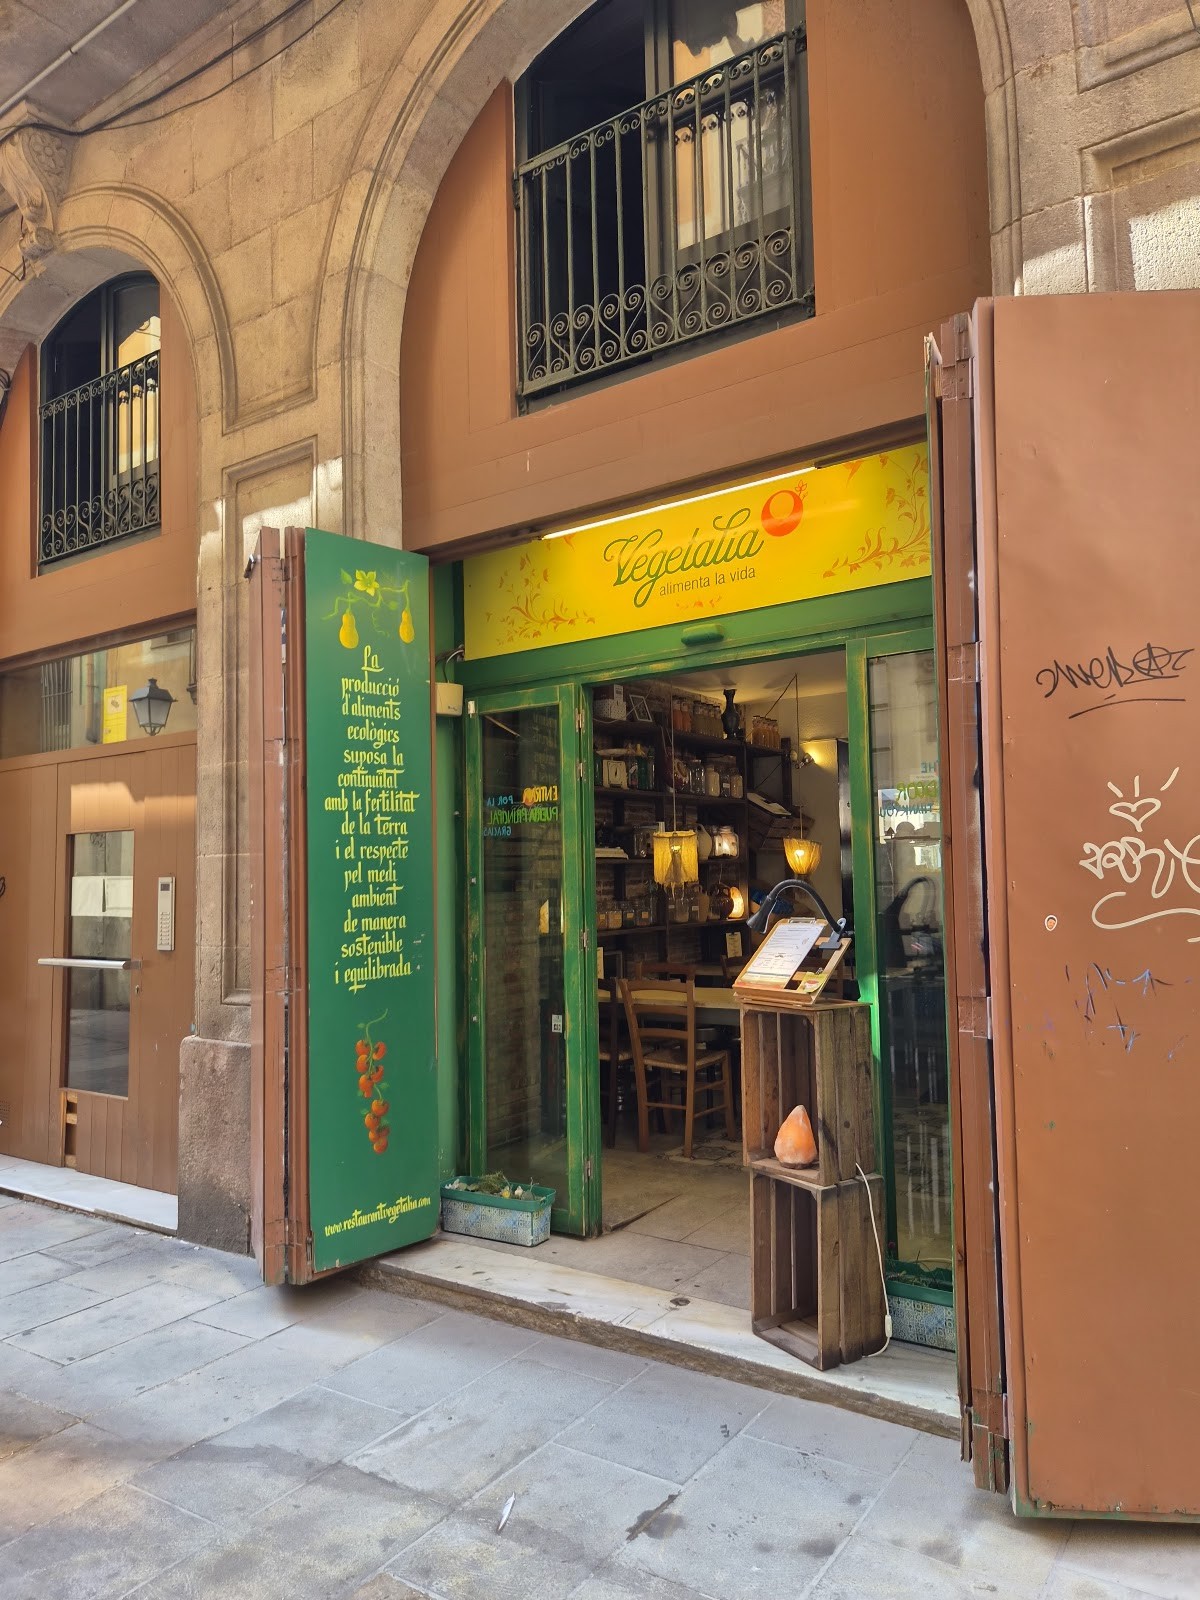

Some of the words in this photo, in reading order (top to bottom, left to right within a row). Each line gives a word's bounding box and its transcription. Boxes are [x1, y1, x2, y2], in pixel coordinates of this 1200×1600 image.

[603, 507, 764, 608] Vegetalia
[659, 575, 710, 597] alimenta
[715, 572, 726, 585] la
[730, 566, 756, 582] vida
[361, 645, 384, 672] La
[341, 671, 400, 700] producció
[342, 693, 401, 720] d'aliments
[347, 719, 400, 749] ecològics
[343, 749, 387, 768] suposa
[392, 745, 404, 766] la
[324, 788, 348, 811] amb
[352, 790, 362, 811] la
[365, 789, 420, 817] fertilitat
[341, 811, 355, 835] de
[359, 812, 371, 835] la
[373, 813, 408, 835] terra
[335, 840, 340, 859] i
[344, 836, 355, 859] el
[360, 837, 409, 866] respecte
[344, 861, 363, 892] pel
[367, 860, 398, 883] medi
[351, 883, 404, 908] ambient
[343, 909, 358, 933] de
[361, 915, 406, 931] manera
[341, 931, 404, 958] sostenible
[335, 962, 340, 984] i
[344, 953, 413, 995] equilibrada
[324, 1195, 431, 1236] www.restaurantvegetalia.com
